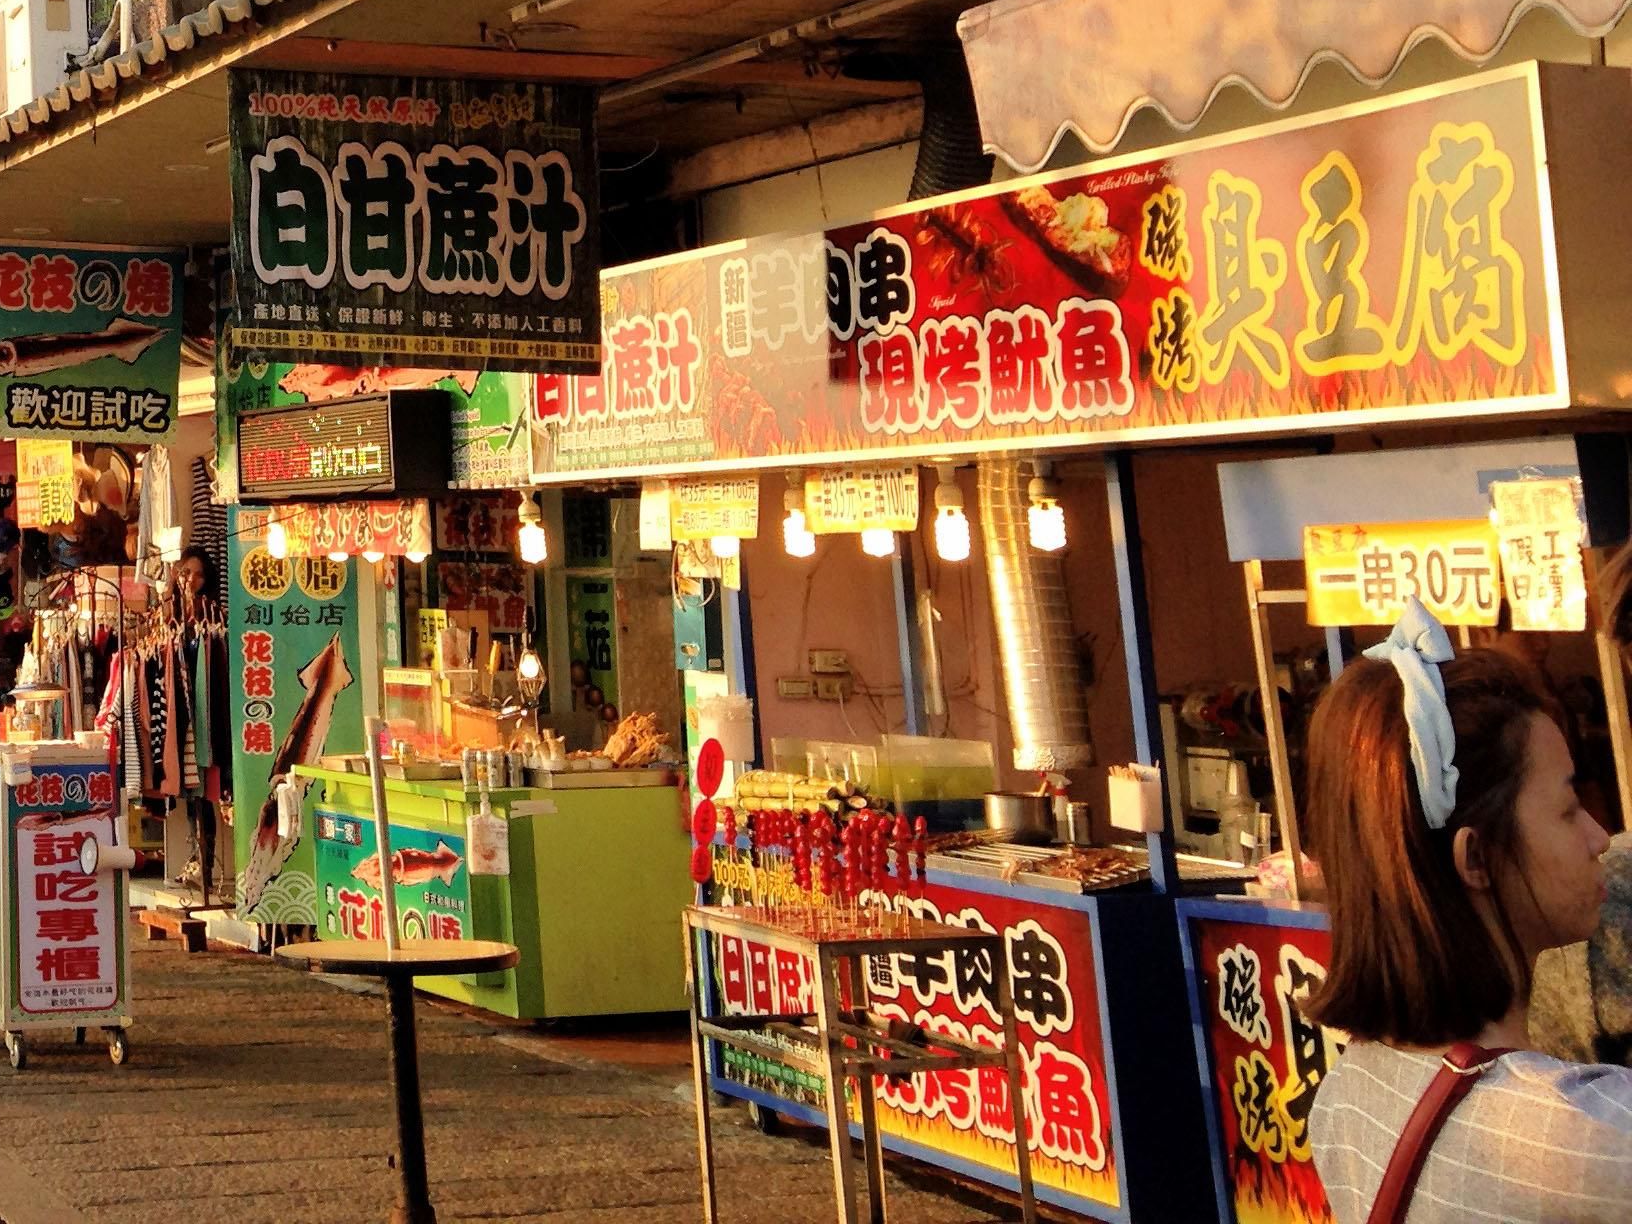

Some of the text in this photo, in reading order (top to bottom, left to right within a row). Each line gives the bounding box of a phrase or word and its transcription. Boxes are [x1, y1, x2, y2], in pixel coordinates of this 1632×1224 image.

[249, 135, 588, 300] 白甘蔗汁
[753, 228, 916, 351] 羊肉串
[6, 383, 170, 431] 歡迎試吃
[859, 296, 1135, 436] 現烤魷魚
[244, 603, 346, 626] 創始店
[1319, 544, 1494, 610] 一串30元
[242, 630, 274, 754] 花枝の燒
[32, 830, 101, 982] 試吃專櫃
